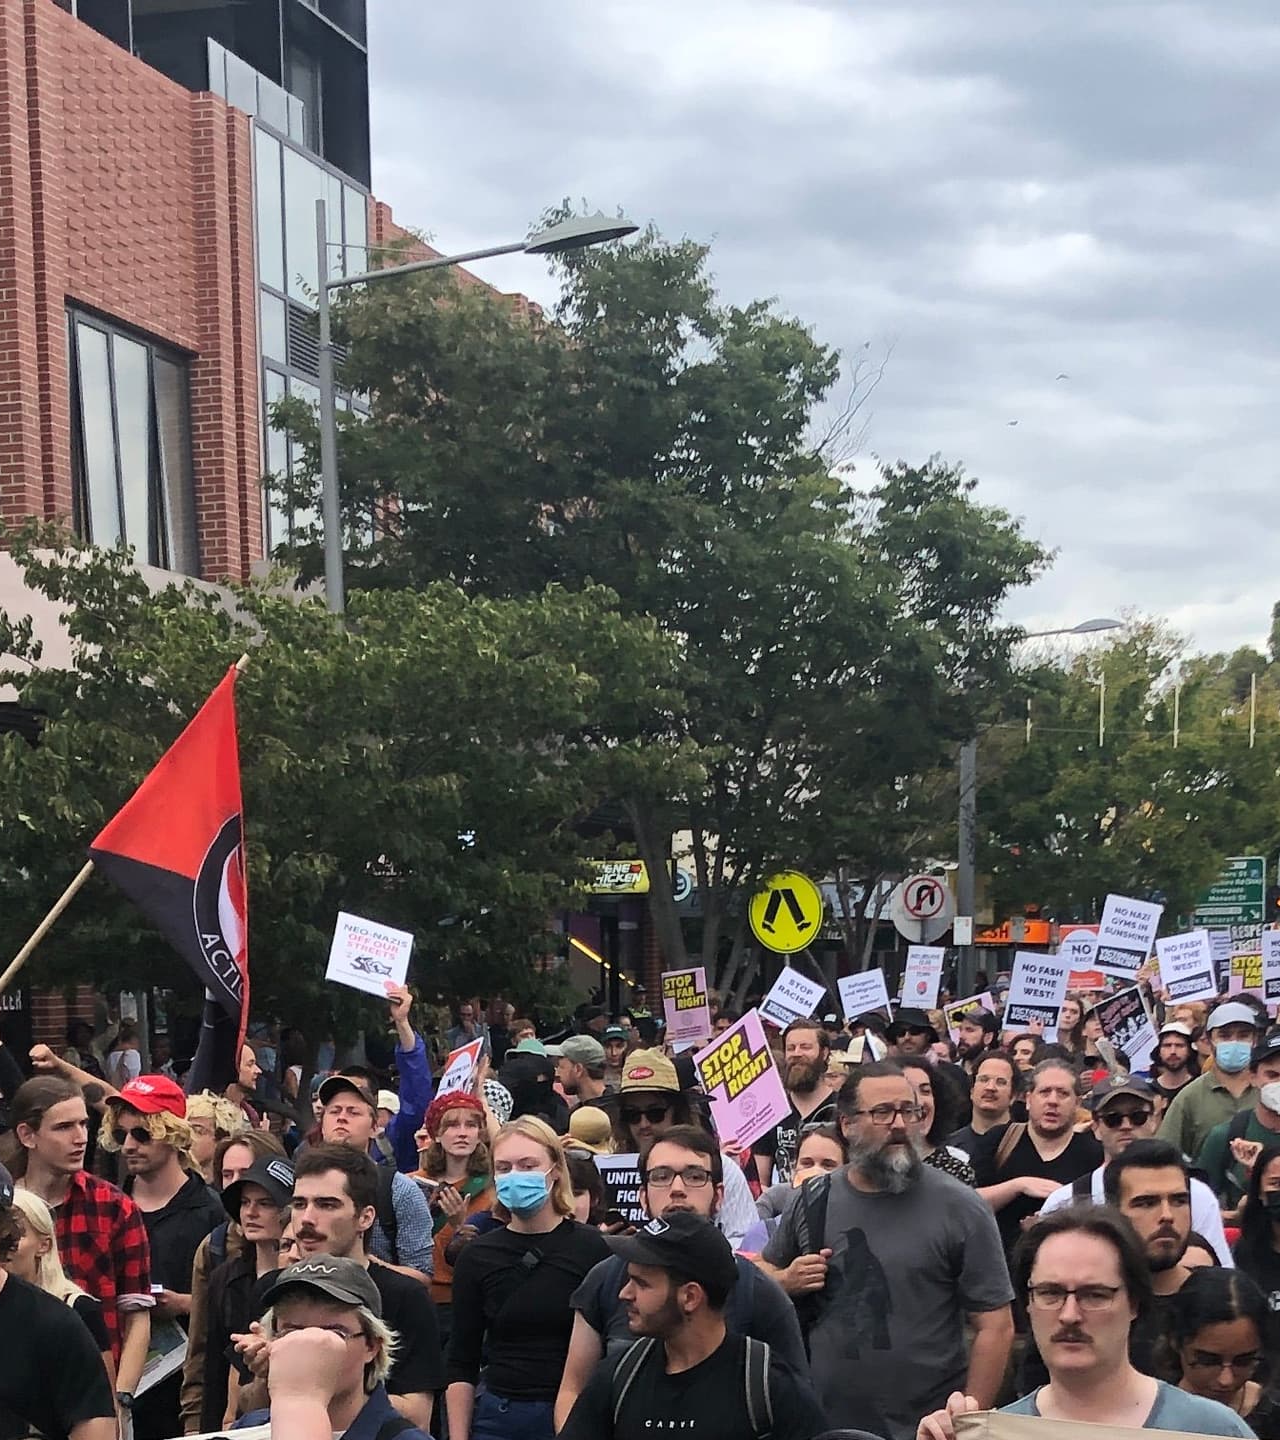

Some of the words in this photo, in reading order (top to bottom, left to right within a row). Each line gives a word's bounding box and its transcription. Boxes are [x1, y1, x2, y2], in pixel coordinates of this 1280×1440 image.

[1114, 907, 1129, 917] NO
[1129, 910, 1152, 922] NAZI
[989, 925, 1031, 939] SHP
[1111, 917, 1137, 930] GYMS
[1137, 923, 1149, 932] IN
[1104, 926, 1150, 943] SUNSHINE
[346, 940, 396, 960] STREETS
[1072, 944, 1092, 955] NO
[1164, 945, 1177, 954] NO
[1171, 954, 1181, 962] IN
[1183, 950, 1200, 959] THE
[1021, 963, 1037, 973] NO
[1038, 966, 1064, 977] FASH
[664, 974, 692, 991] STOP
[789, 977, 814, 997] STOP
[1025, 976, 1036, 985] IN
[1038, 977, 1058, 988] THE
[676, 985, 695, 998] FAR
[778, 984, 814, 1009] RACISM
[1023, 987, 1055, 1000] WEST!
[677, 995, 706, 1009] RIGHT
[701, 1032, 743, 1080] STOP
[723, 1048, 752, 1083] FAR
[727, 1051, 769, 1098] RIGHT
